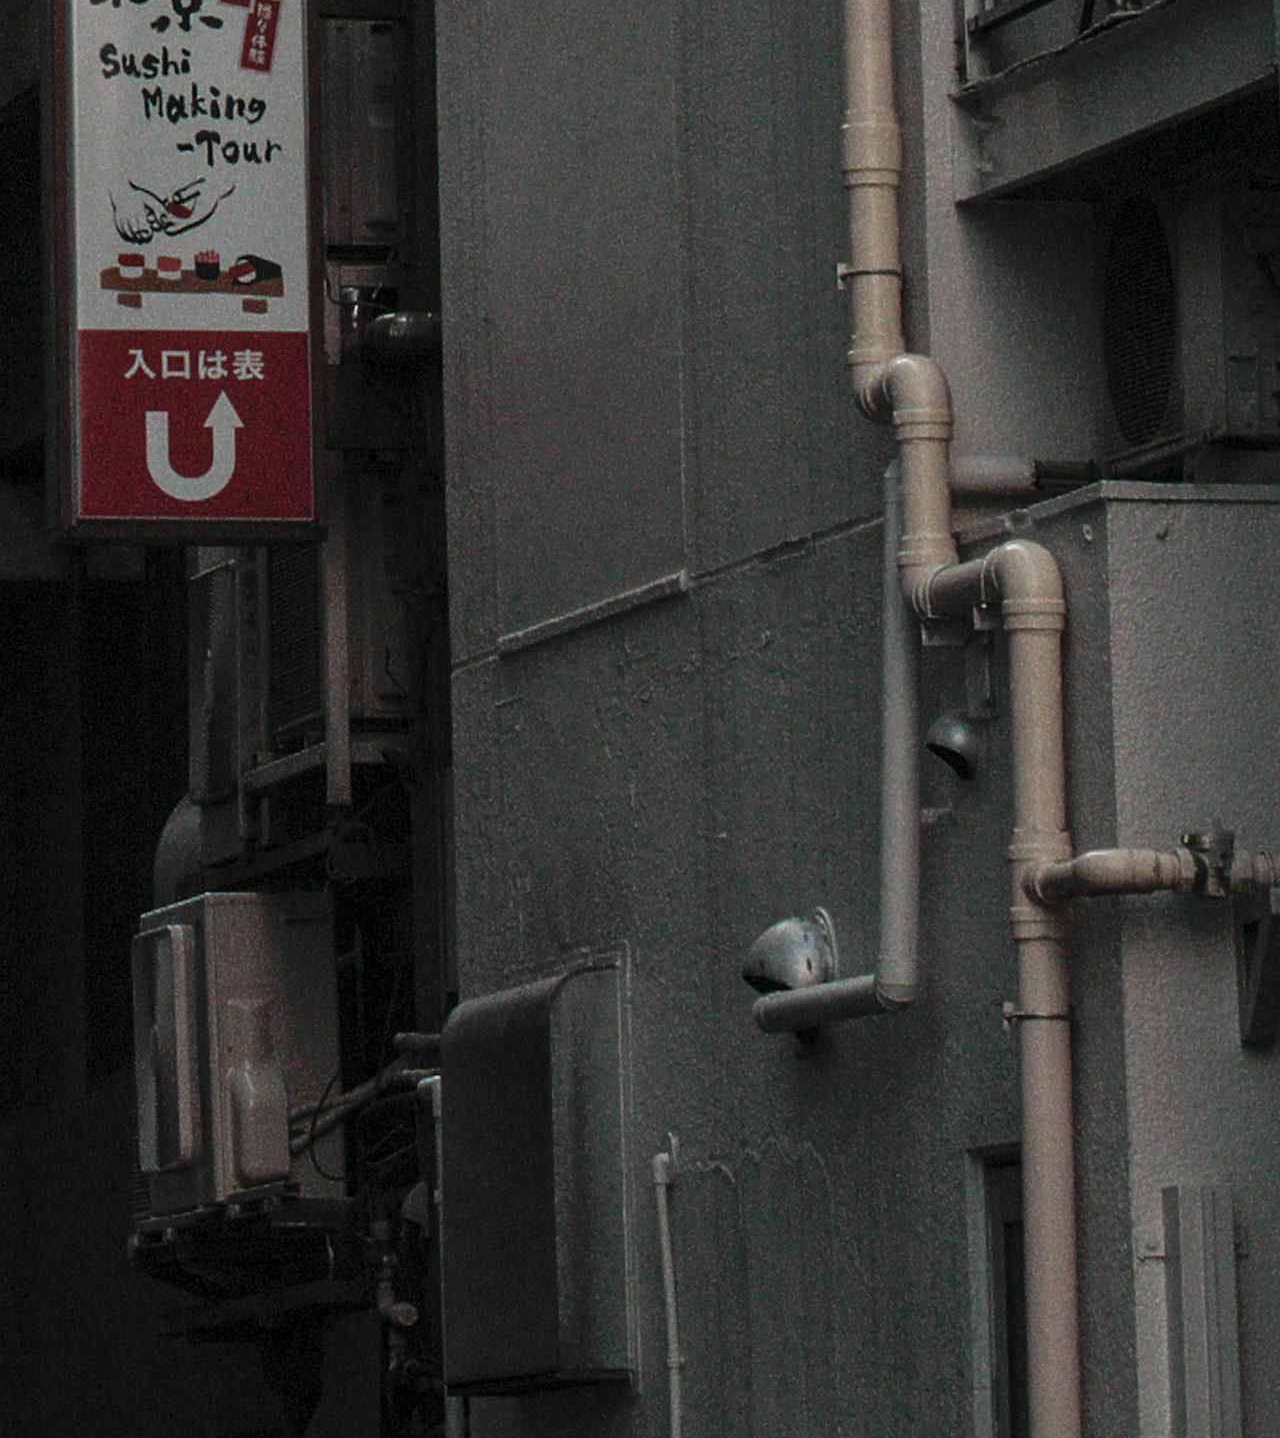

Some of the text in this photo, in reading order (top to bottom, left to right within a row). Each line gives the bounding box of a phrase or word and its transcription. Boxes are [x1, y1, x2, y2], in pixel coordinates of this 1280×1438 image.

[99, 43, 191, 79] Sushi
[142, 82, 266, 124] Making
[123, 348, 265, 380] 入口は表
